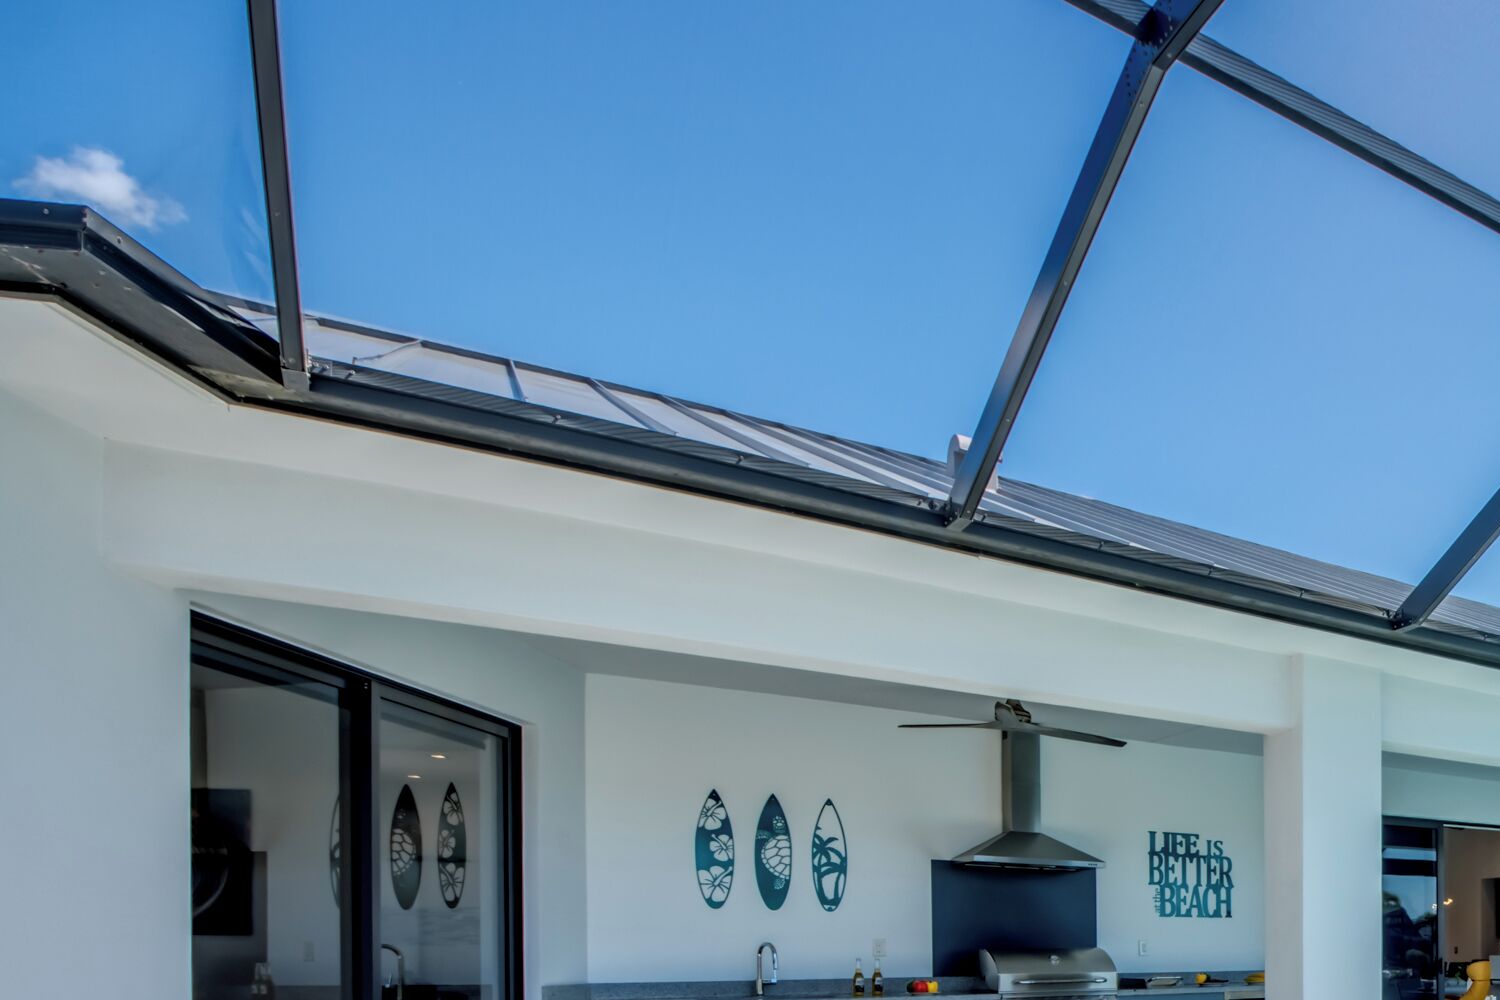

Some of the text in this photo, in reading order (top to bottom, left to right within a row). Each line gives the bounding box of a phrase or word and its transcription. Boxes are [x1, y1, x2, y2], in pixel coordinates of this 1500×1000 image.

[1148, 831, 1224, 857] LIFE IS
[1148, 852, 1234, 888] BETTER
[1159, 884, 1232, 918] BEACH
